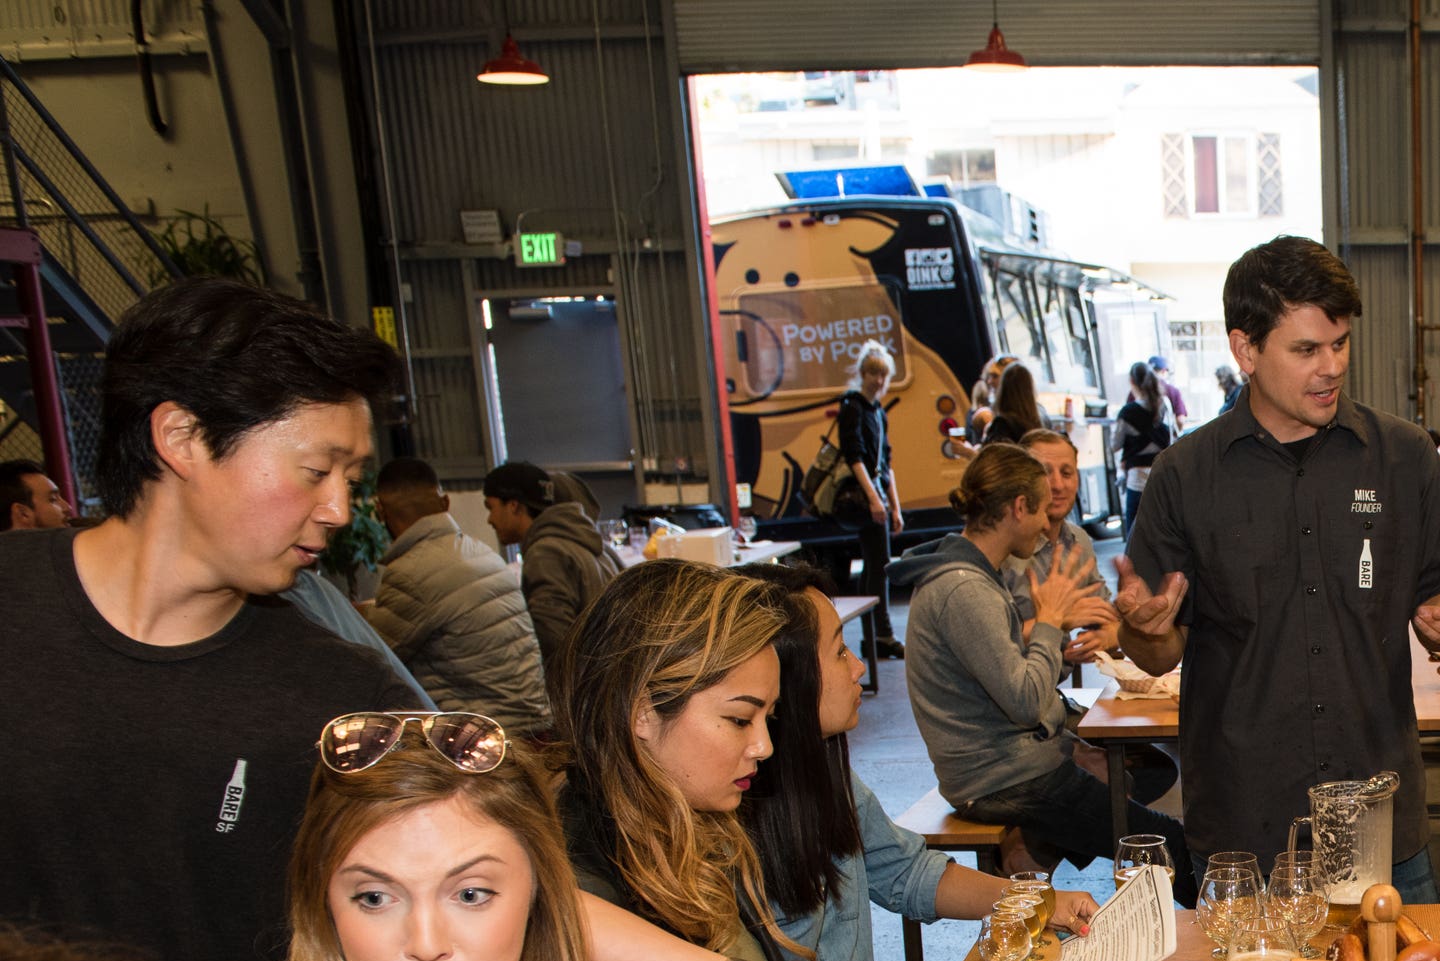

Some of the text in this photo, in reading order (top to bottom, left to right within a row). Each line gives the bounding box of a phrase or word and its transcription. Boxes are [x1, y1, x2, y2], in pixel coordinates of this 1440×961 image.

[521, 233, 556, 263] EXIT
[782, 314, 894, 346] POWERED
[799, 335, 897, 364] BY POK
[1350, 502, 1382, 513] FOUNDER
[1354, 489, 1377, 501] MIKE
[1361, 560, 1371, 586] BARE
[221, 785, 243, 820] BARE
[215, 822, 236, 833] SF
